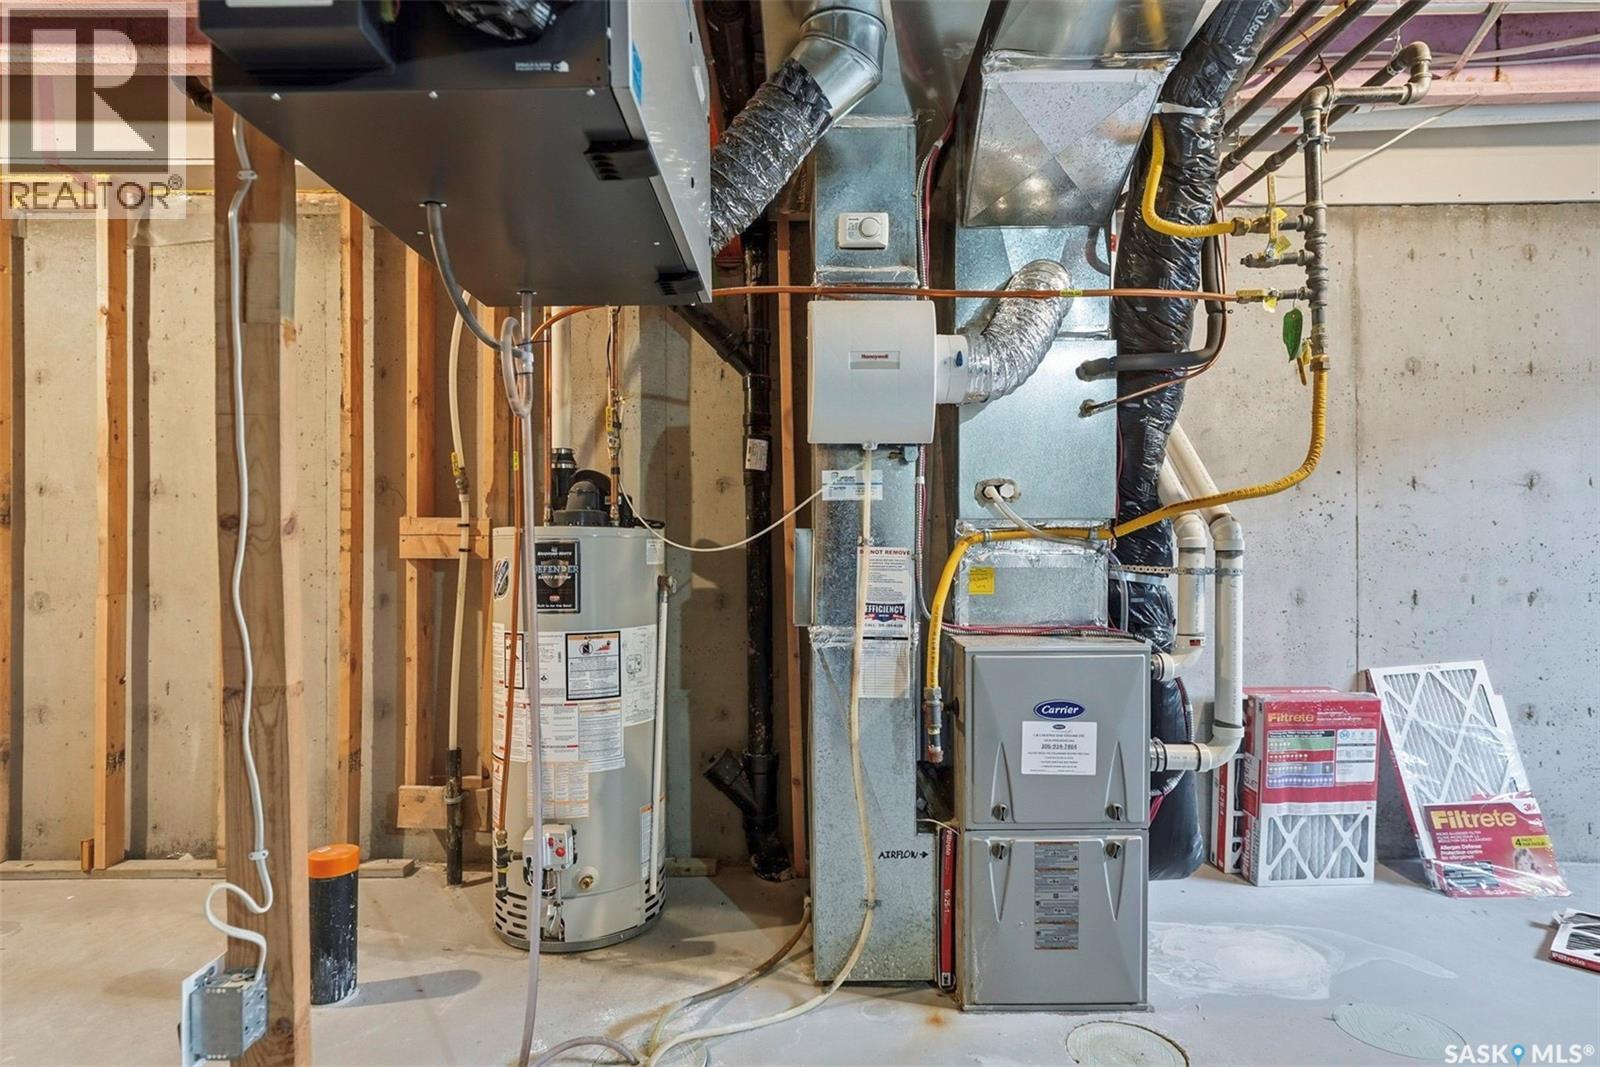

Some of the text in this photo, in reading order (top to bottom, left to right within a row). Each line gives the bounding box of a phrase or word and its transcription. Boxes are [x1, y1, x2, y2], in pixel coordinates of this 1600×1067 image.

[1041, 705, 1079, 714] Carrier
[1267, 712, 1314, 722] Filtrete
[1430, 809, 1517, 829] Filtrete
